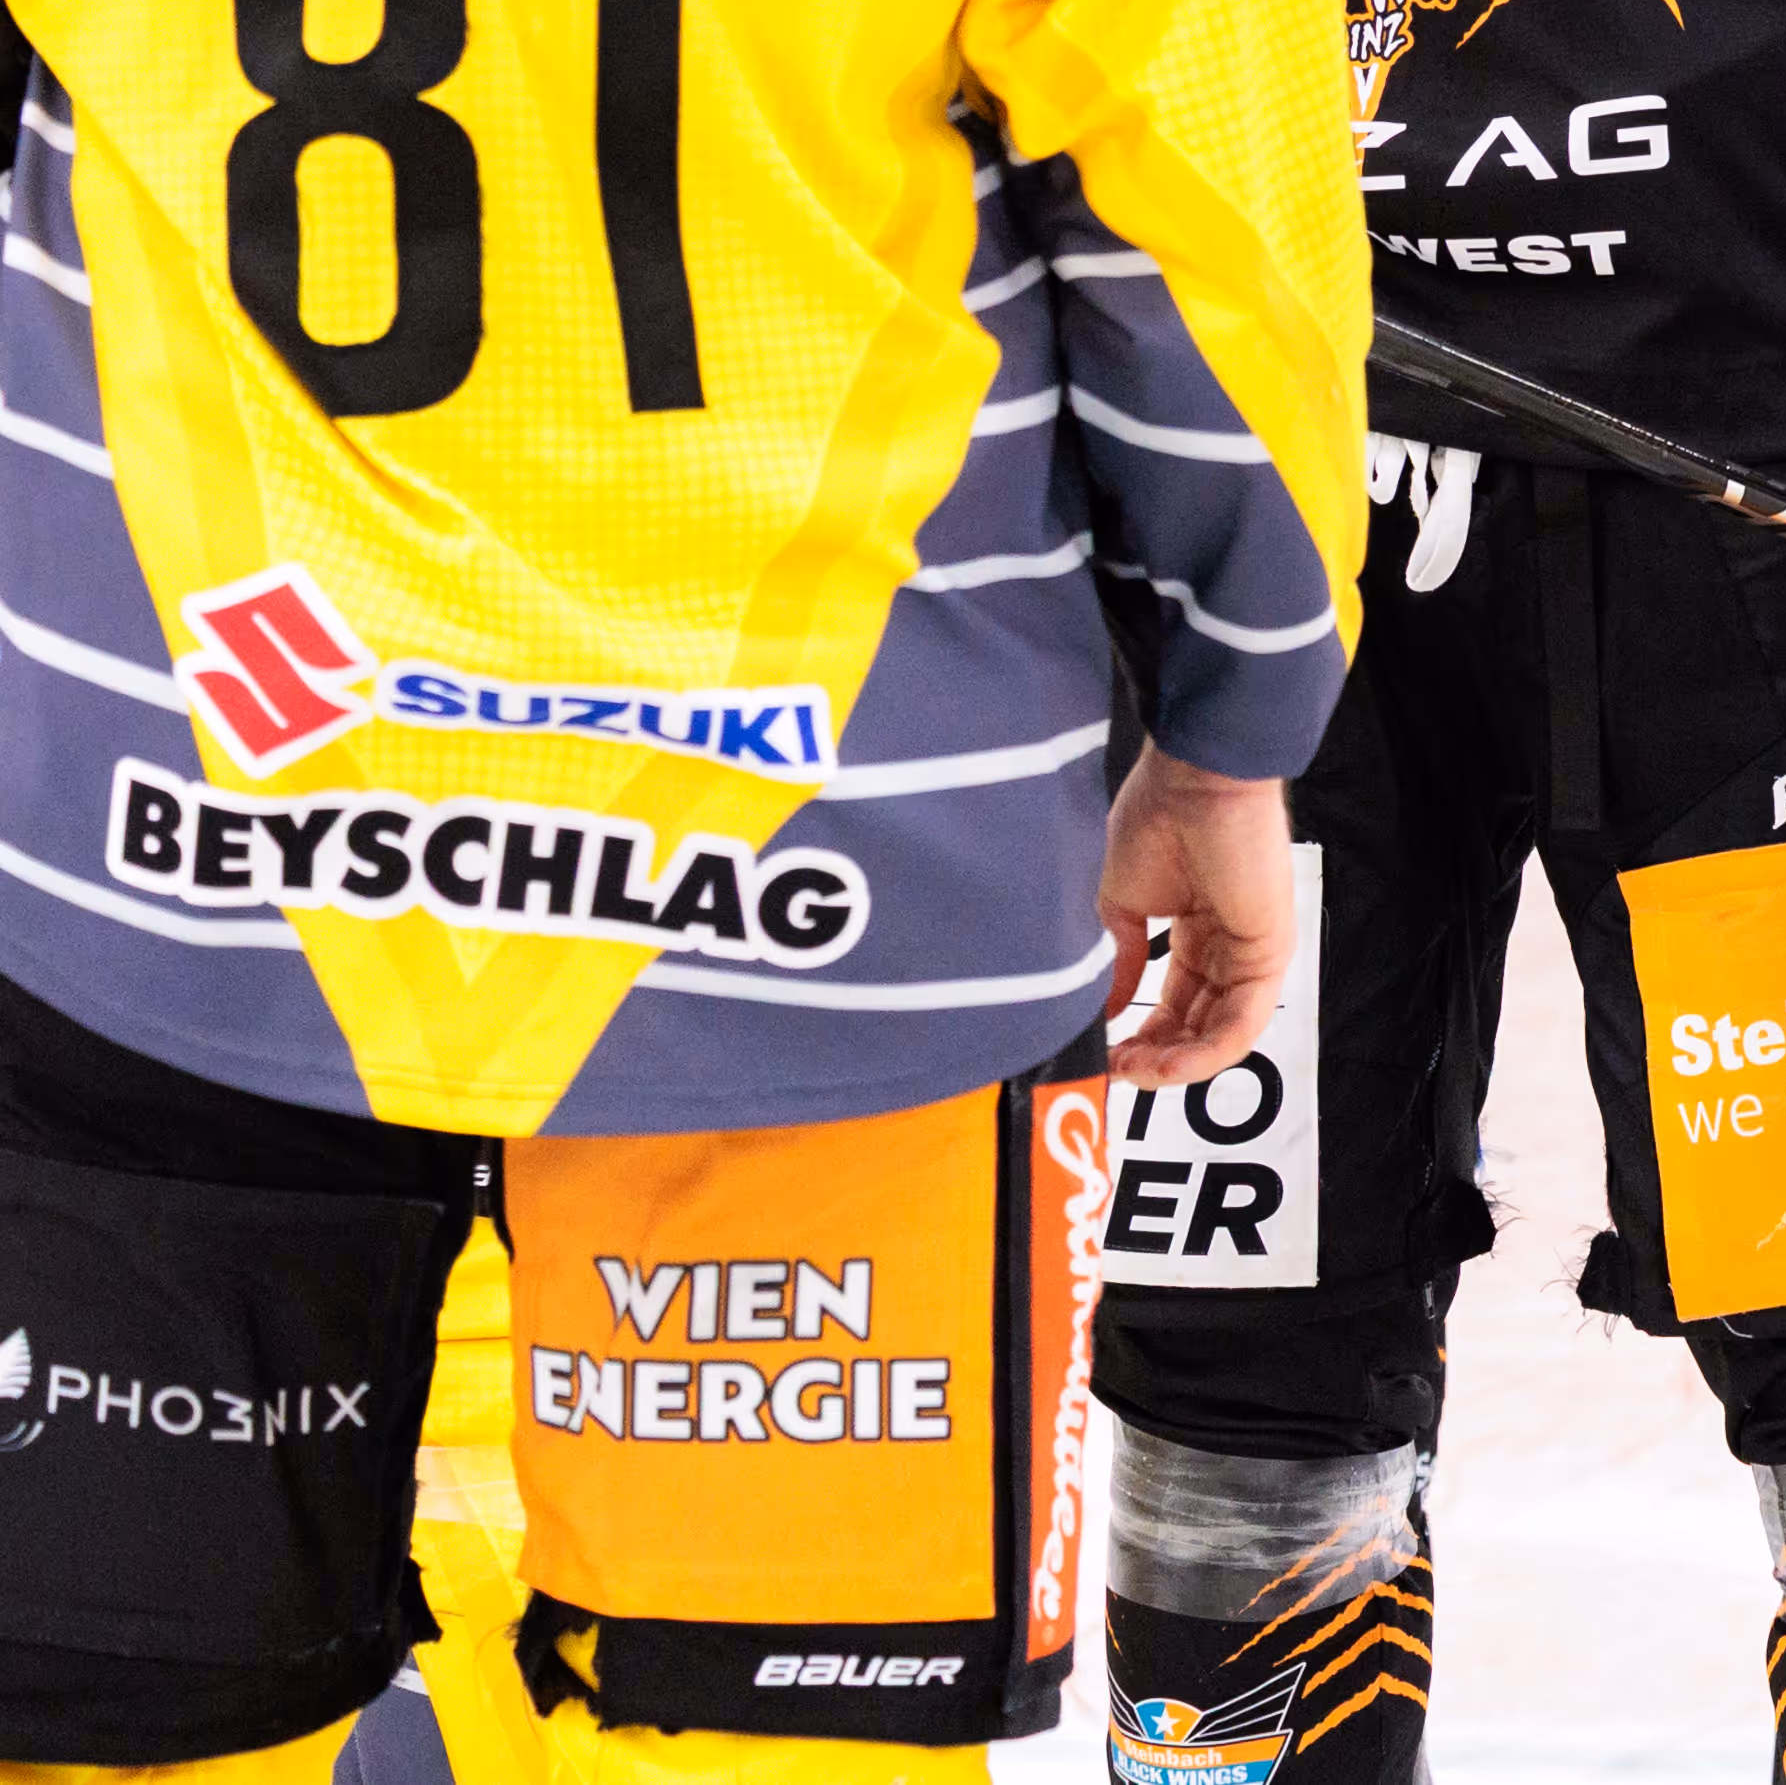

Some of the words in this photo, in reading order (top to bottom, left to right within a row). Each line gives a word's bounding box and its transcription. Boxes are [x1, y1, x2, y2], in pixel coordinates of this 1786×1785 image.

[1445, 94, 1671, 188] AG
[391, 673, 824, 766] SUZUKI
[122, 779, 853, 950] BEYSCHLAG
[1679, 1092, 1764, 1146] we
[1102, 1158, 1284, 1256] ER
[596, 1254, 874, 1344] WIEN
[531, 1344, 952, 1443] ENERGIE
[753, 1654, 964, 1687] BAUER
